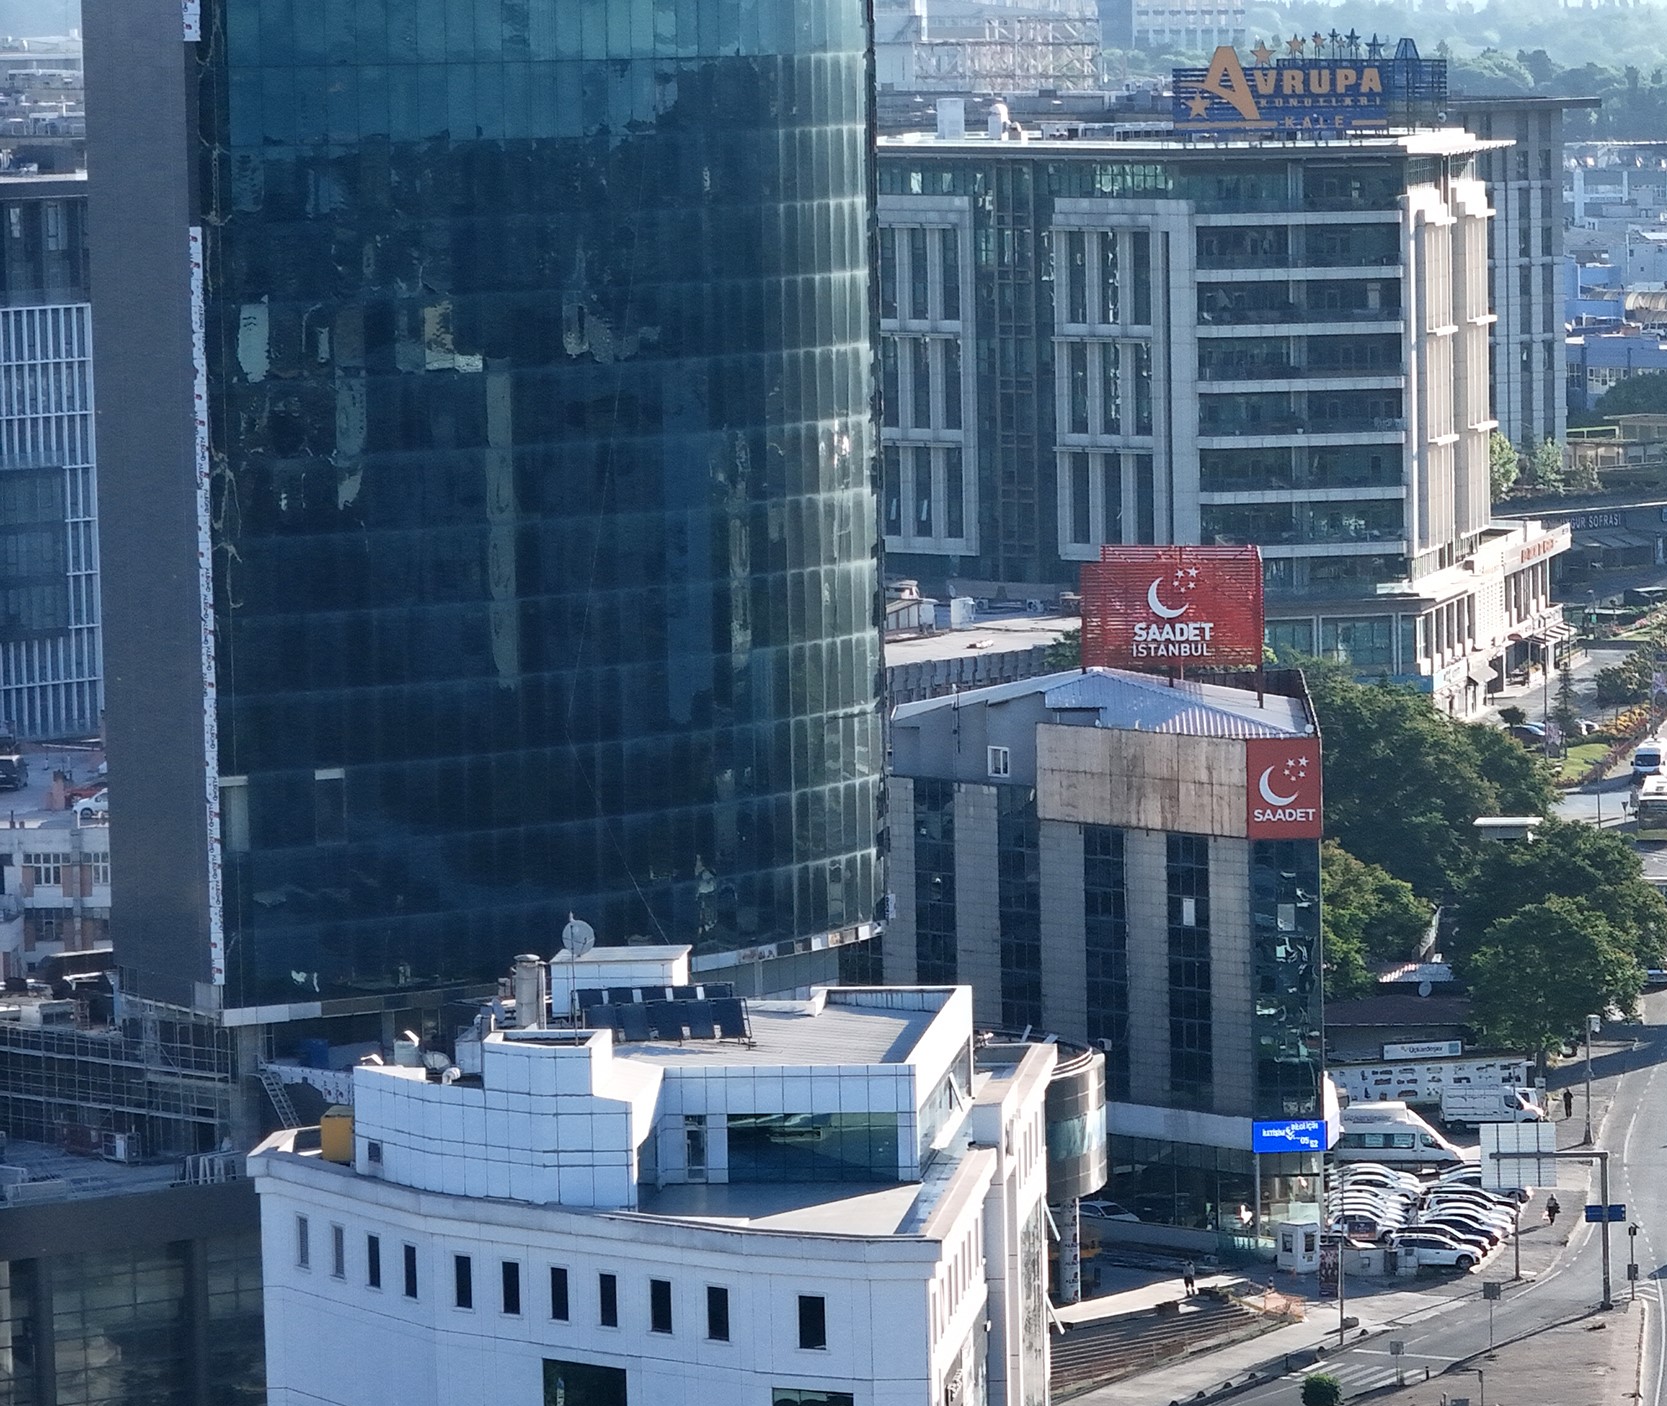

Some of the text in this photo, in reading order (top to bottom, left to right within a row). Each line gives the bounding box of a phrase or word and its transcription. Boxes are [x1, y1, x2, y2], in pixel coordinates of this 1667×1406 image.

[1203, 46, 1382, 120] AVRUPA
[1284, 115, 1345, 128] KALE
[1588, 513, 1621, 528] SOFRASI
[1132, 622, 1215, 641] SAADET
[1253, 808, 1317, 822] SAADET
